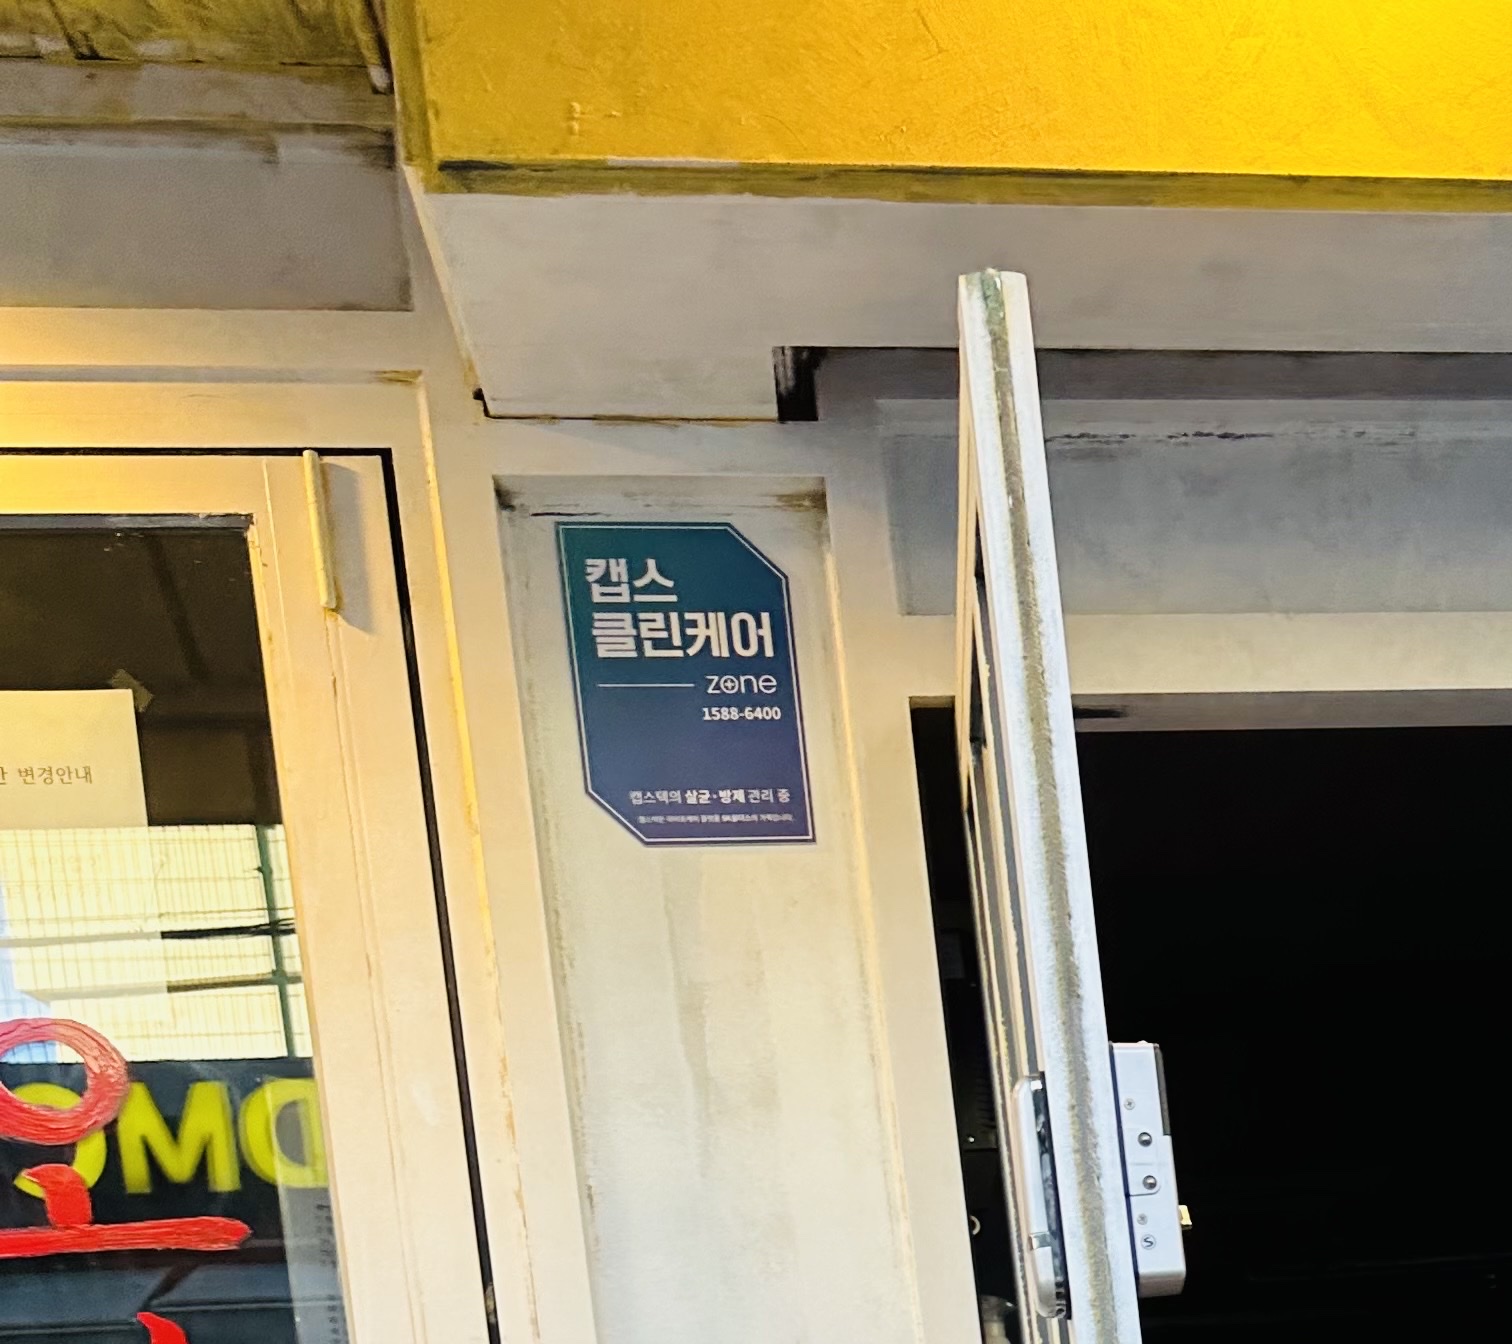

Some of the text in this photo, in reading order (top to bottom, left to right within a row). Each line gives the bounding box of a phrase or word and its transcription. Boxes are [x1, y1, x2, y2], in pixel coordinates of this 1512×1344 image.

[584, 557, 678, 603] 캡스
[591, 611, 775, 658] 클린케어
[705, 674, 777, 694] zone
[702, 706, 782, 721] 1588-6400
[17, 765, 93, 785] 변경안내
[747, 788, 775, 804] 관리
